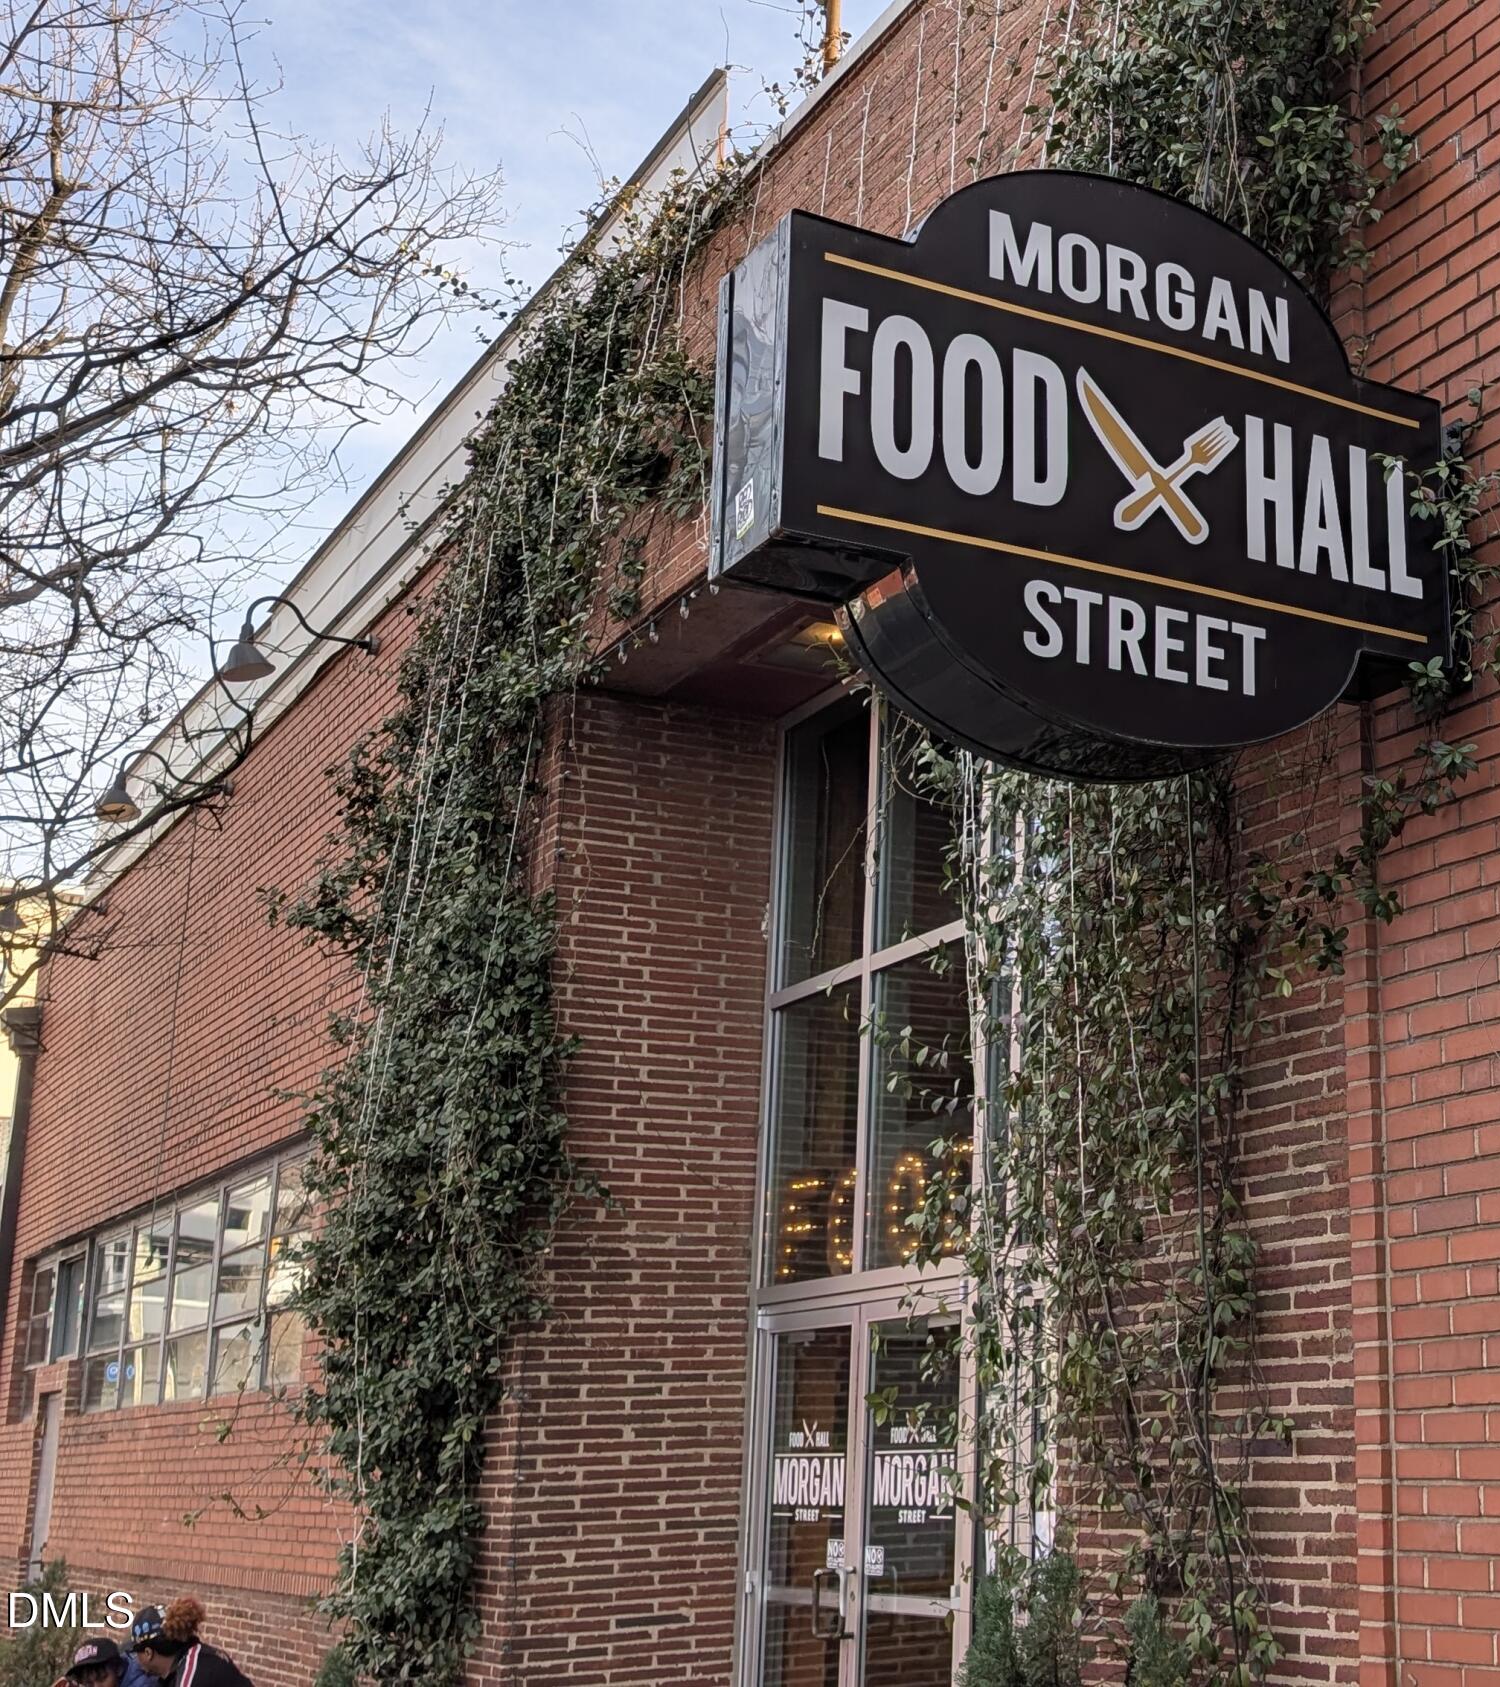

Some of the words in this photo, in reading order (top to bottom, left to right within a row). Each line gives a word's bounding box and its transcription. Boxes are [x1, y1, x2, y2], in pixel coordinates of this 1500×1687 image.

[988, 208, 1291, 364] MORGAN
[818, 297, 1069, 507] FOOD
[1245, 414, 1423, 599] HALL
[1023, 579, 1267, 697] STREET
[789, 1432, 804, 1447] FOOD
[815, 1431, 829, 1447] HALL
[890, 1426, 909, 1444] FOOD
[773, 1458, 845, 1506] MORGAN
[873, 1454, 955, 1507] MORGAN
[795, 1509, 820, 1522] STREET
[898, 1509, 927, 1523] STREET
